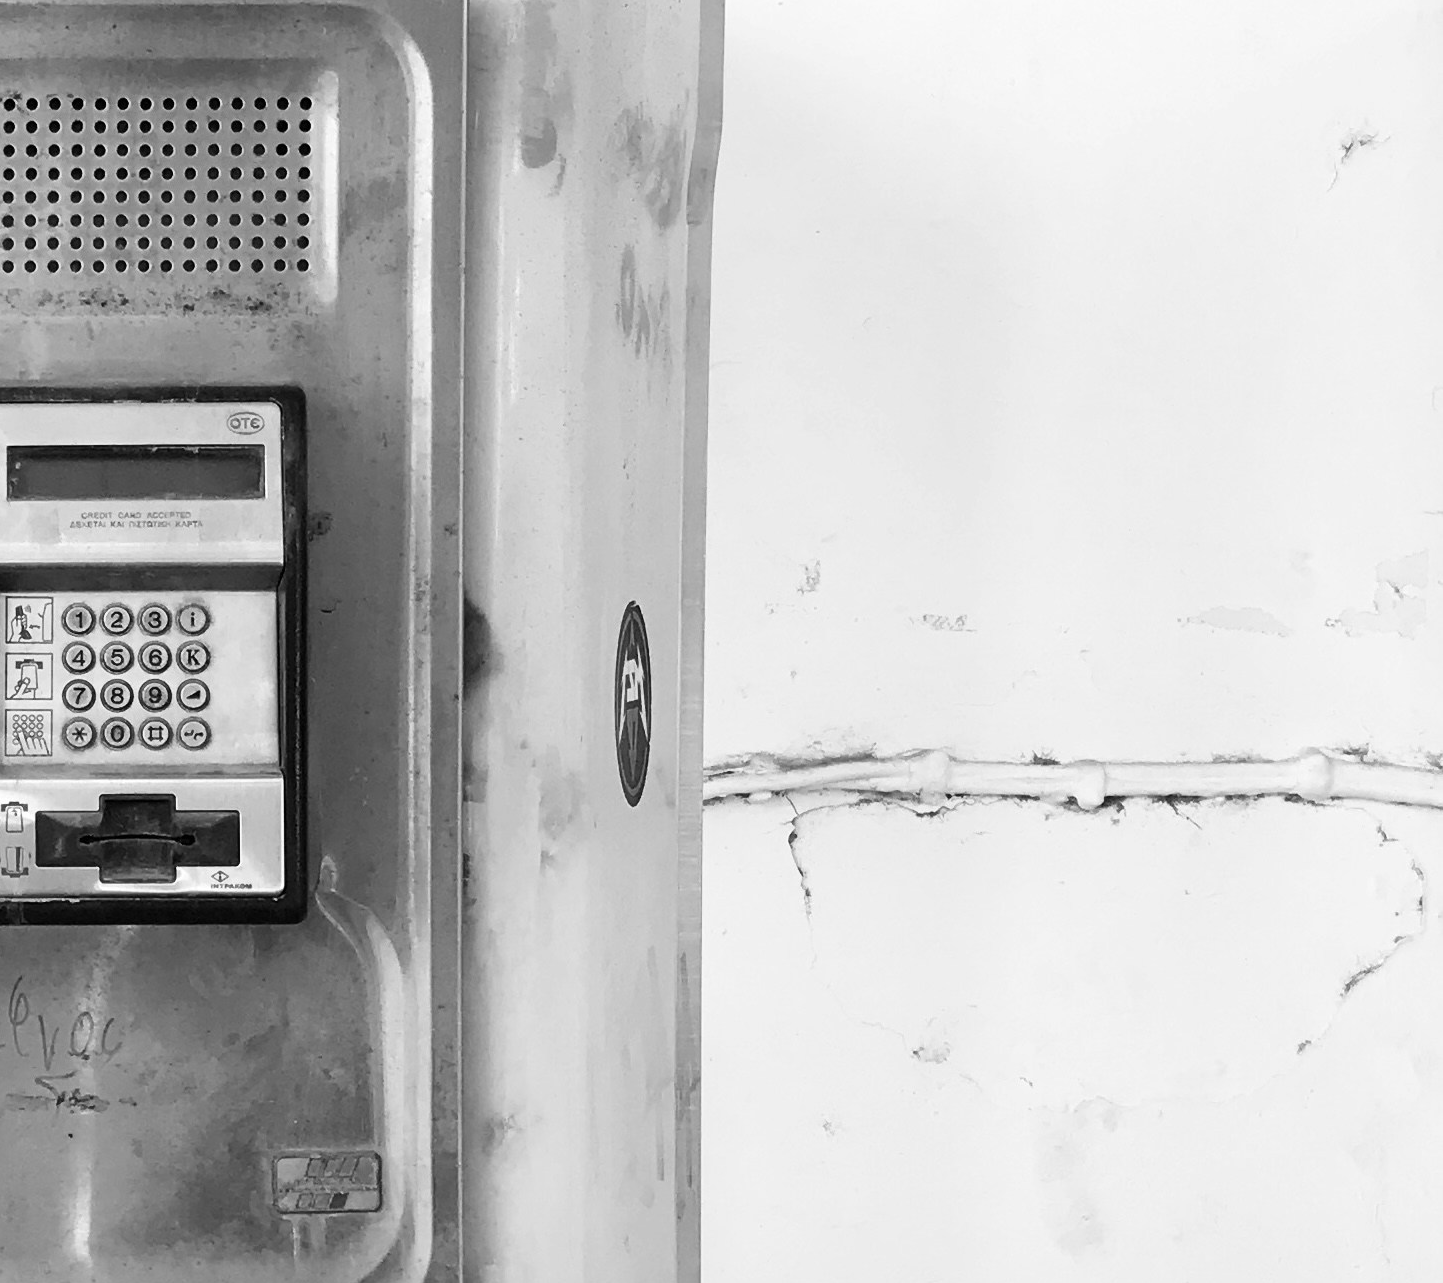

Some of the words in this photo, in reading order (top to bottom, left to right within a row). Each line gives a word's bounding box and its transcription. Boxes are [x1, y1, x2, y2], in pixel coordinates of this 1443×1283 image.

[80, 511, 112, 520] CREDIT
[75, 611, 84, 629] 1
[110, 611, 124, 629] 2
[147, 611, 162, 629] 3
[71, 649, 86, 667] 4
[110, 648, 125, 667] 5
[148, 648, 163, 667] 6
[72, 687, 87, 705] 7
[110, 686, 125, 705] 8
[148, 686, 162, 704] 9
[110, 724, 125, 743] 0
